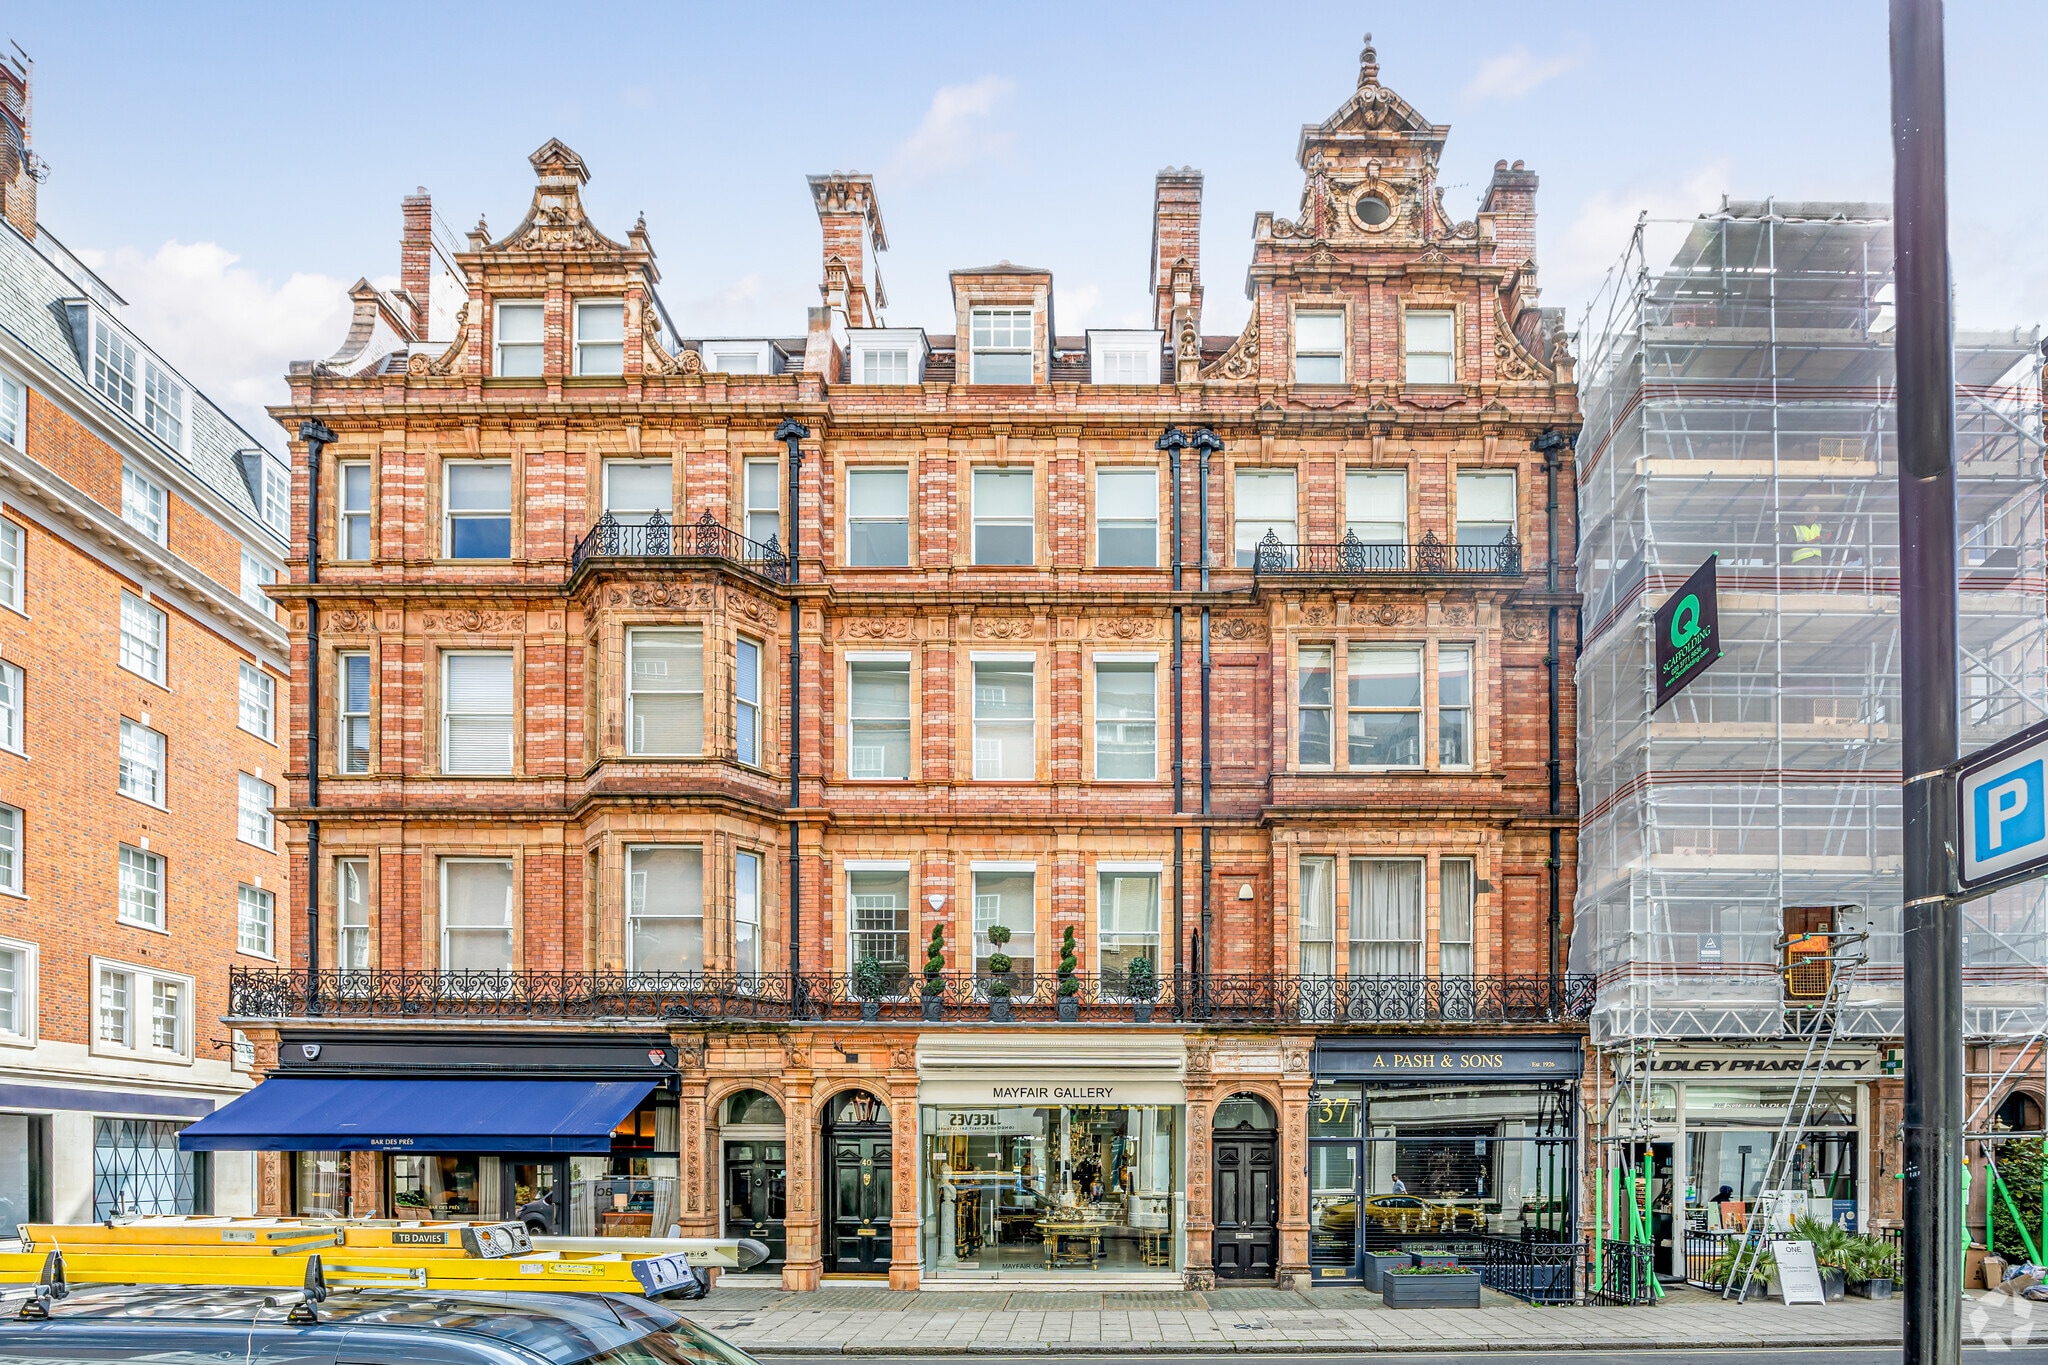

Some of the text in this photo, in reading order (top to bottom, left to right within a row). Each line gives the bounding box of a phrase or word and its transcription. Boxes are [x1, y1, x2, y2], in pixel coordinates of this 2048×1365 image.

[1670, 593, 1701, 649] Q
[1662, 624, 1711, 674] SCAFFOLDING
[1988, 777, 2028, 851] P
[1373, 1054, 1503, 1068] A. PASH & SONS
[1633, 1060, 1728, 1071] AUDLEY
[993, 1087, 1113, 1098] MAYFAIR GALLERY
[1318, 1098, 1349, 1123] 37
[399, 1137, 414, 1145] PRÉS
[399, 1233, 442, 1243] TB DAVIES
